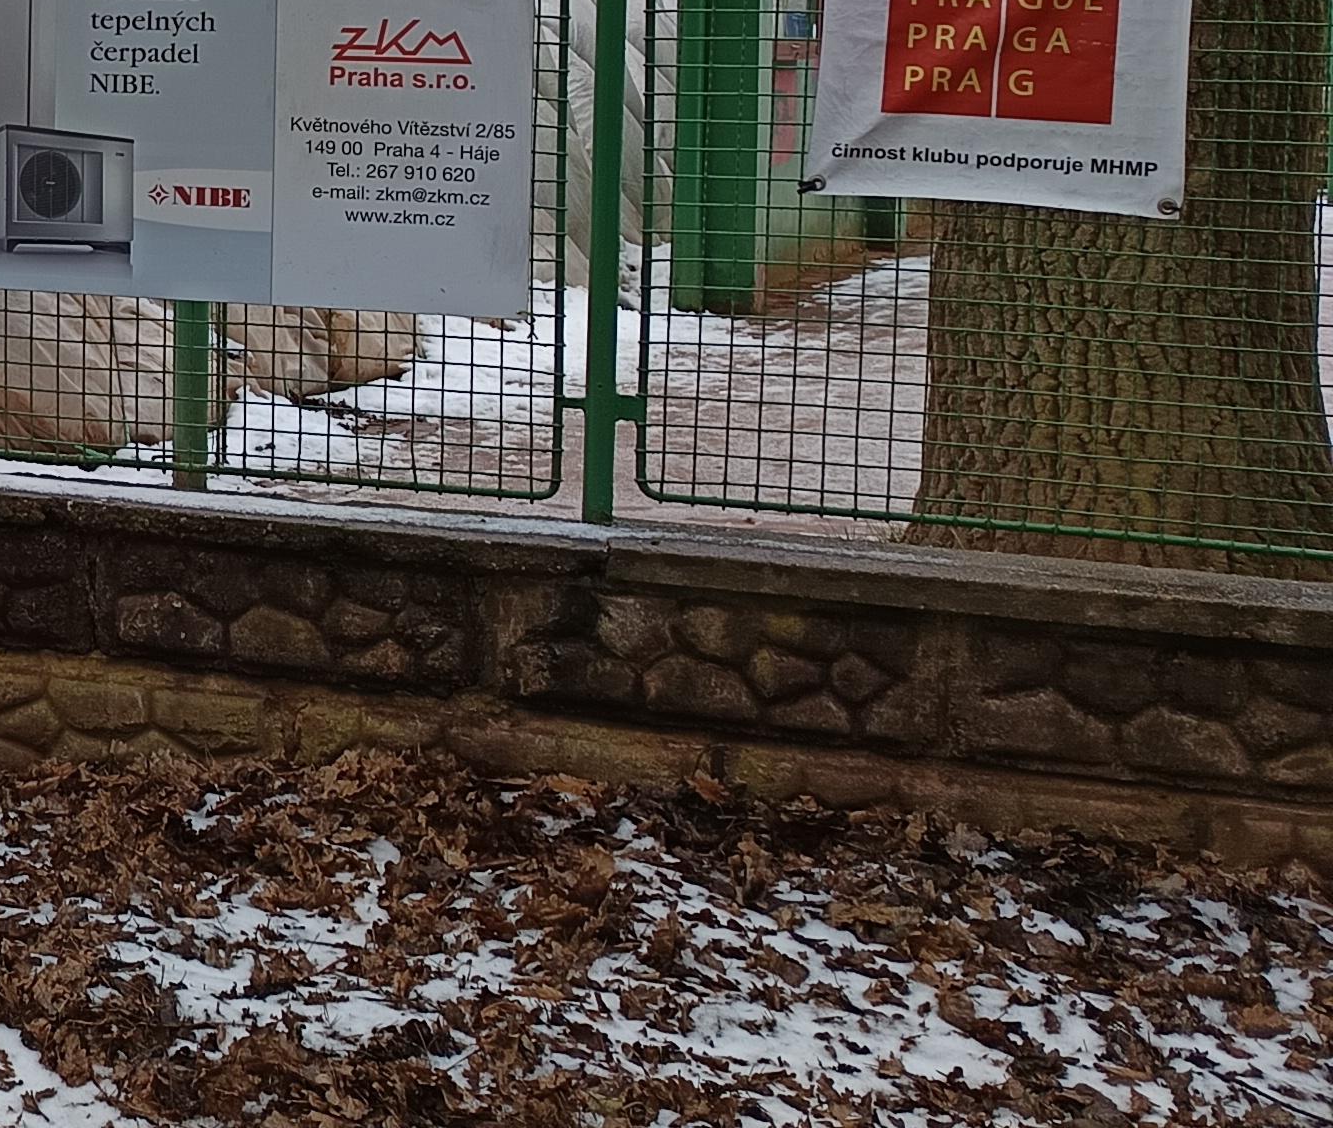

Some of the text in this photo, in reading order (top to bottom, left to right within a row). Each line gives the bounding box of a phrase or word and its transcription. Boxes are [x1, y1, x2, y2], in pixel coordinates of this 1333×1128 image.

[91, 10, 217, 37] tepelných
[90, 40, 201, 68] čerpadel
[89, 73, 161, 95] NIBE.
[329, 66, 476, 90] Praha s.r.o.
[290, 117, 516, 140] Květnového Vítězství 2/85
[304, 140, 336, 155] 149
[341, 141, 363, 156] 00
[374, 142, 425, 159] Praha
[429, 144, 441, 159] 4
[460, 145, 500, 164] Háje
[831, 143, 1159, 178] činnost klubu podporuje MHMP
[326, 162, 476, 183] Tel.: 267 910 620
[172, 185, 251, 208] NIBE
[312, 185, 491, 206] e-mail: zkm@zkm.cz
[345, 209, 456, 227] www.zkm.cz
